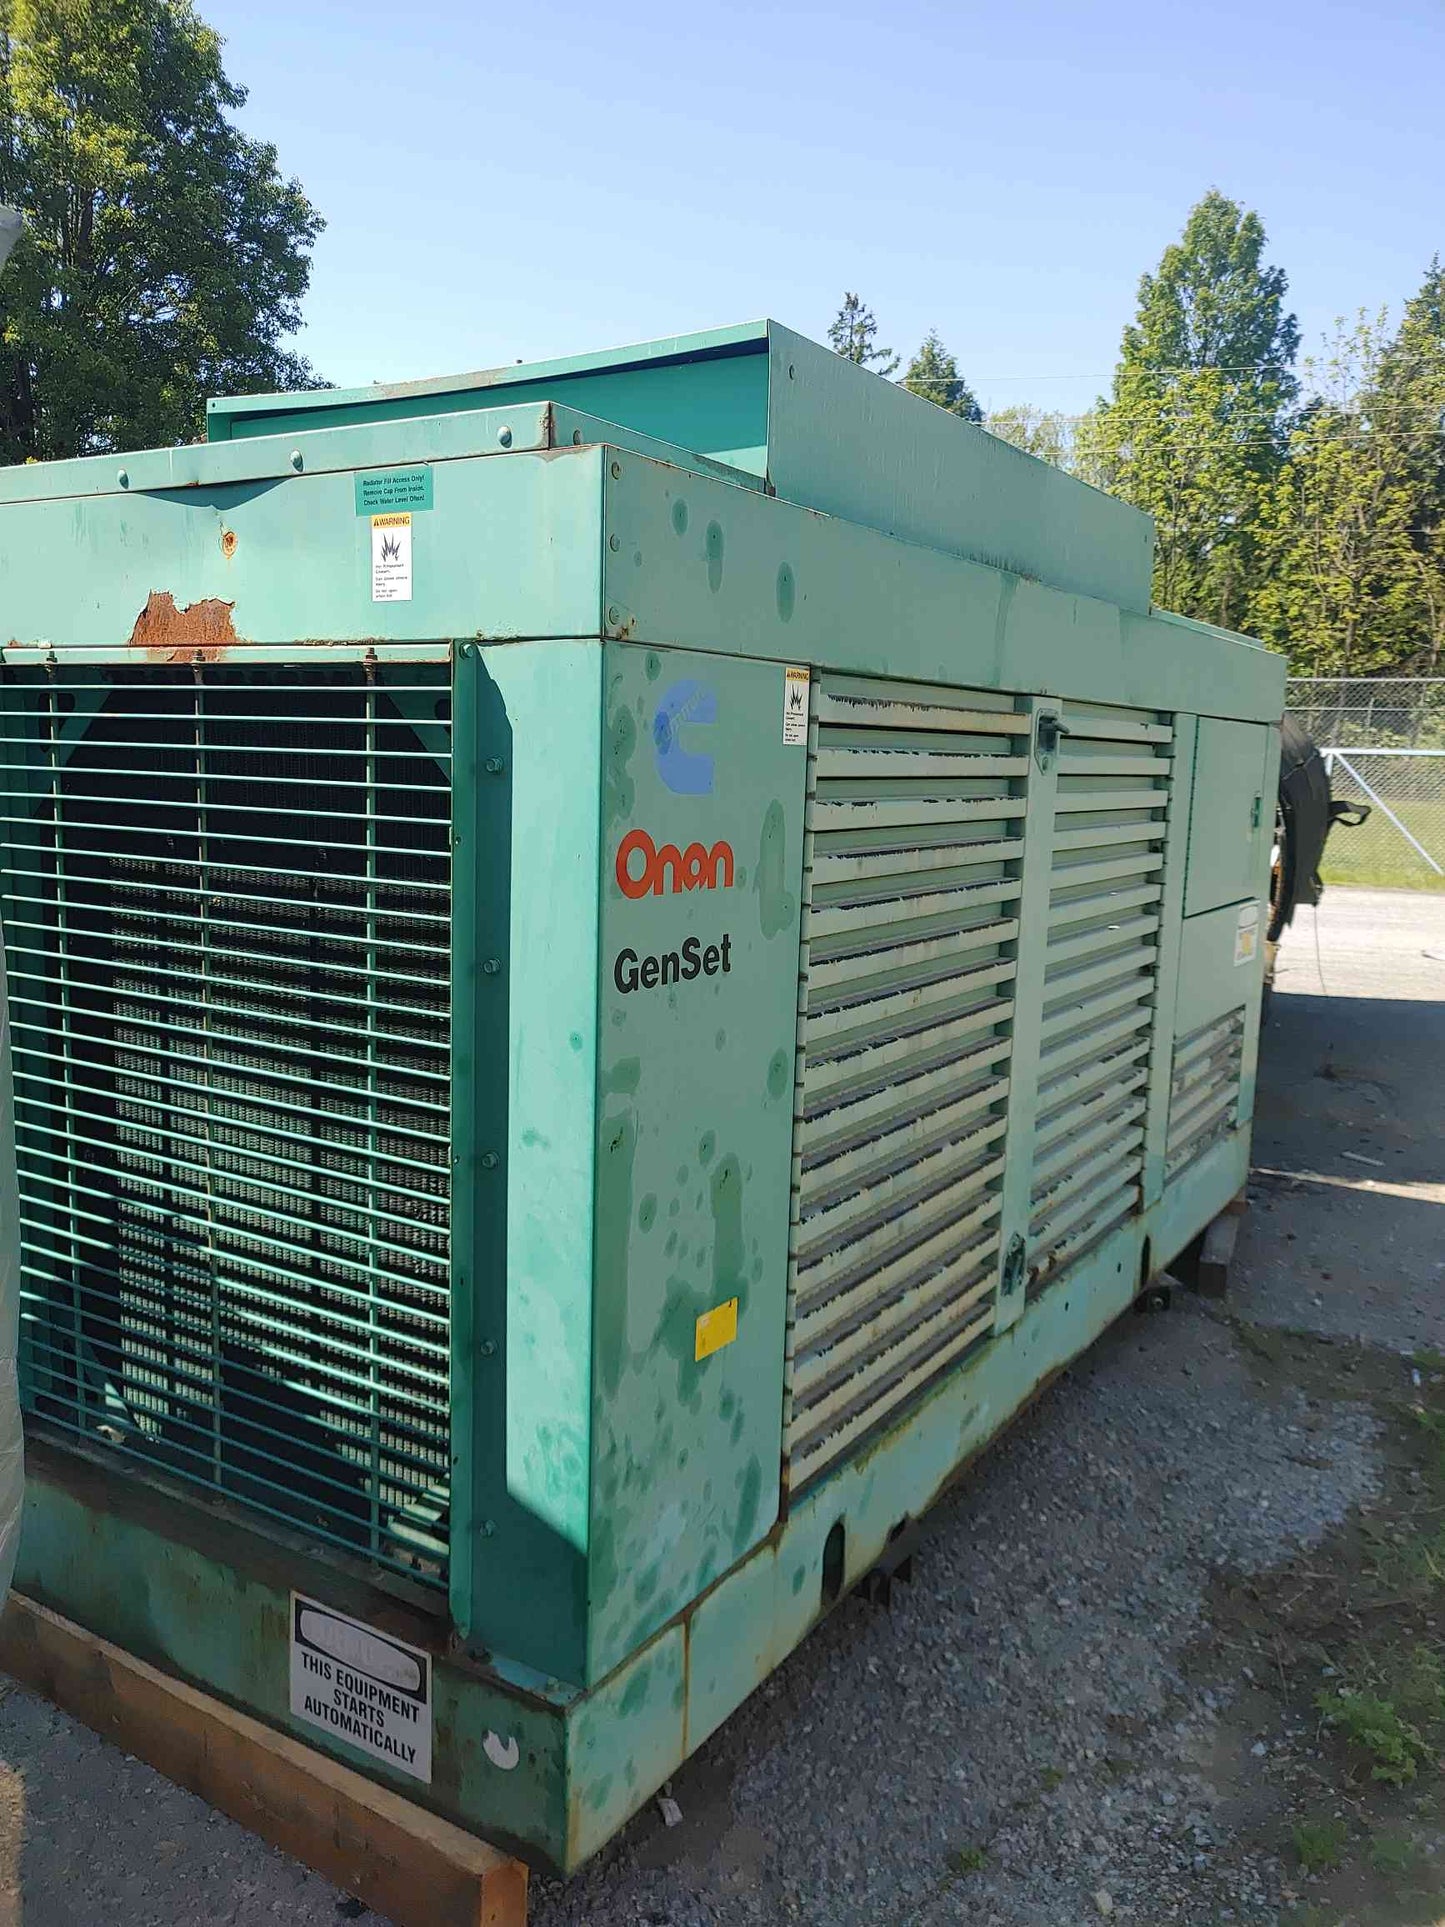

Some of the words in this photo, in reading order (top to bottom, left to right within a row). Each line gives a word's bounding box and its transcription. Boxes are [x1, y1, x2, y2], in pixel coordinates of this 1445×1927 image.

[383, 477, 391, 485] Fill
[392, 476, 410, 484] Access
[394, 486, 407, 494] From
[395, 495, 408, 503] Level
[380, 516, 410, 526] WARNING
[616, 829, 734, 899] Onan
[614, 933, 732, 994] GenSet
[301, 1651, 332, 1680] THIS
[336, 1669, 420, 1723] EQUIPMENT
[333, 1688, 385, 1728] STARTS
[304, 1695, 417, 1764] AUTOMATICALLY
